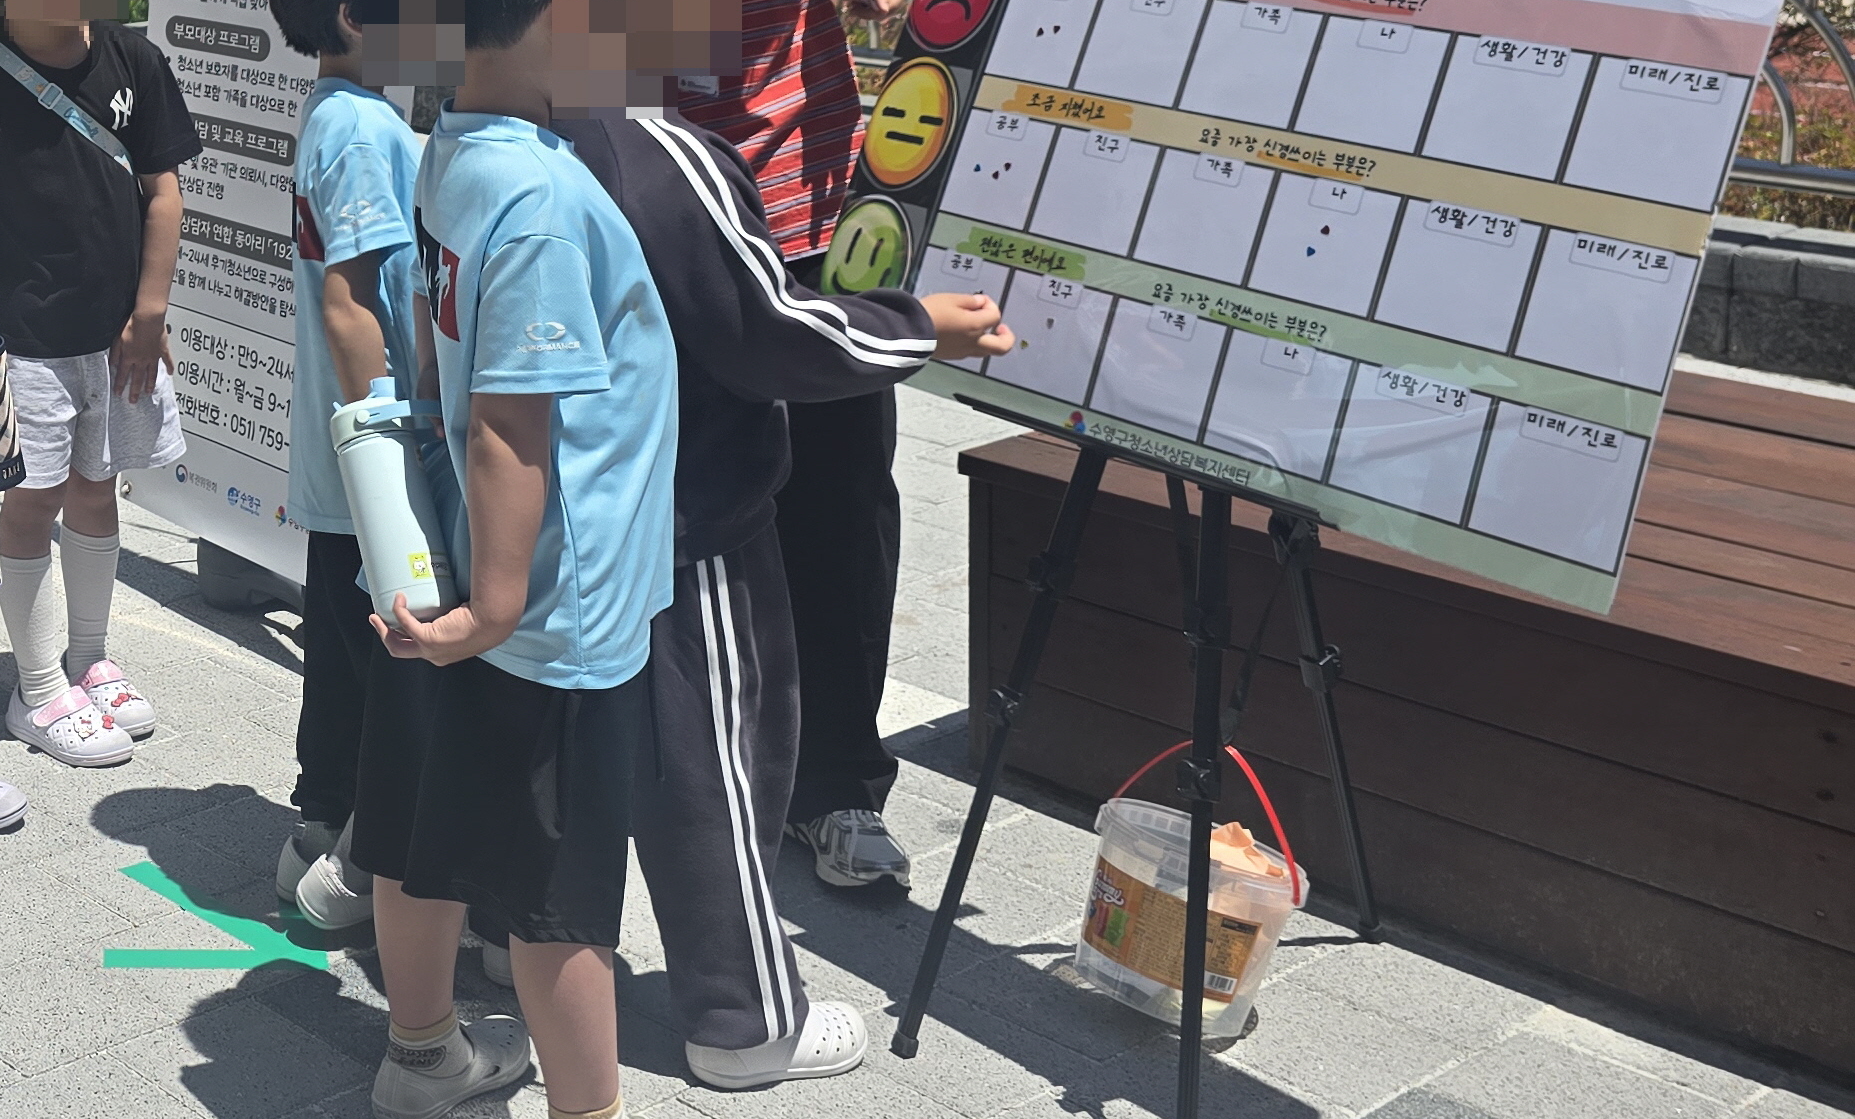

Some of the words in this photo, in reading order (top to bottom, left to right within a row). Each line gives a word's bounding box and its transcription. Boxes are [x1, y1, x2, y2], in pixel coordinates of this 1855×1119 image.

[1254, 5, 1282, 24] 가족
[173, 23, 215, 45] 부모대상
[218, 31, 260, 53] 프로그램
[1380, 26, 1396, 40] 나
[1480, 39, 1567, 68] 생활/건강
[177, 55, 204, 74] 청소년
[205, 60, 239, 81] 보호자를
[241, 68, 275, 87] 대상으로
[279, 73, 287, 91] 한
[1627, 63, 1721, 93] 미래/진로
[109, 88, 133, 130] NY
[204, 84, 221, 102] 포함
[224, 88, 247, 108] 가족을
[250, 94, 285, 113] 대상으로
[287, 100, 297, 118] 한
[1026, 93, 1056, 112] 조금
[996, 115, 1019, 132] 공부
[211, 124, 221, 142] 및
[223, 127, 244, 147] 교육
[245, 133, 288, 158] 프로그램
[1199, 128, 1221, 148] 요즘
[1229, 135, 1257, 153] 가장
[1263, 139, 1326, 167] 신경쓰이는
[1333, 153, 1377, 178] 부분은?
[201, 156, 218, 174] 유관
[220, 162, 238, 179] 기관
[1207, 158, 1234, 178] 가족
[207, 181, 224, 200] 진행
[1332, 187, 1347, 200] 나
[1431, 205, 1517, 238] 생활/건강
[212, 223, 233, 245] 연합
[235, 230, 265, 254] 동아리
[211, 254, 267, 284] 후기청소년으로
[950, 254, 973, 271] 공부
[1577, 237, 1669, 271] 미래/진로
[188, 271, 206, 290] 함께
[208, 279, 232, 298] 나누고
[234, 286, 277, 314] 해결방안을
[1152, 283, 1174, 303] 요즘
[1181, 293, 1210, 310] 가장
[1215, 297, 1278, 329] 신경쓰이는
[1284, 315, 1327, 343] 부분은?
[1159, 310, 1186, 332] 가족
[181, 327, 228, 360] 이용대상
[1284, 347, 1299, 360] 나
[178, 361, 223, 394] 이용시간
[234, 378, 264, 411] 월~금
[1382, 370, 1466, 408] 생활/건강
[175, 392, 220, 426] 전화번호
[1527, 412, 1618, 449] 미래/진로
[1089, 423, 1251, 486] 수영구청소년상담복지센터
[241, 492, 261, 510] 수영구
